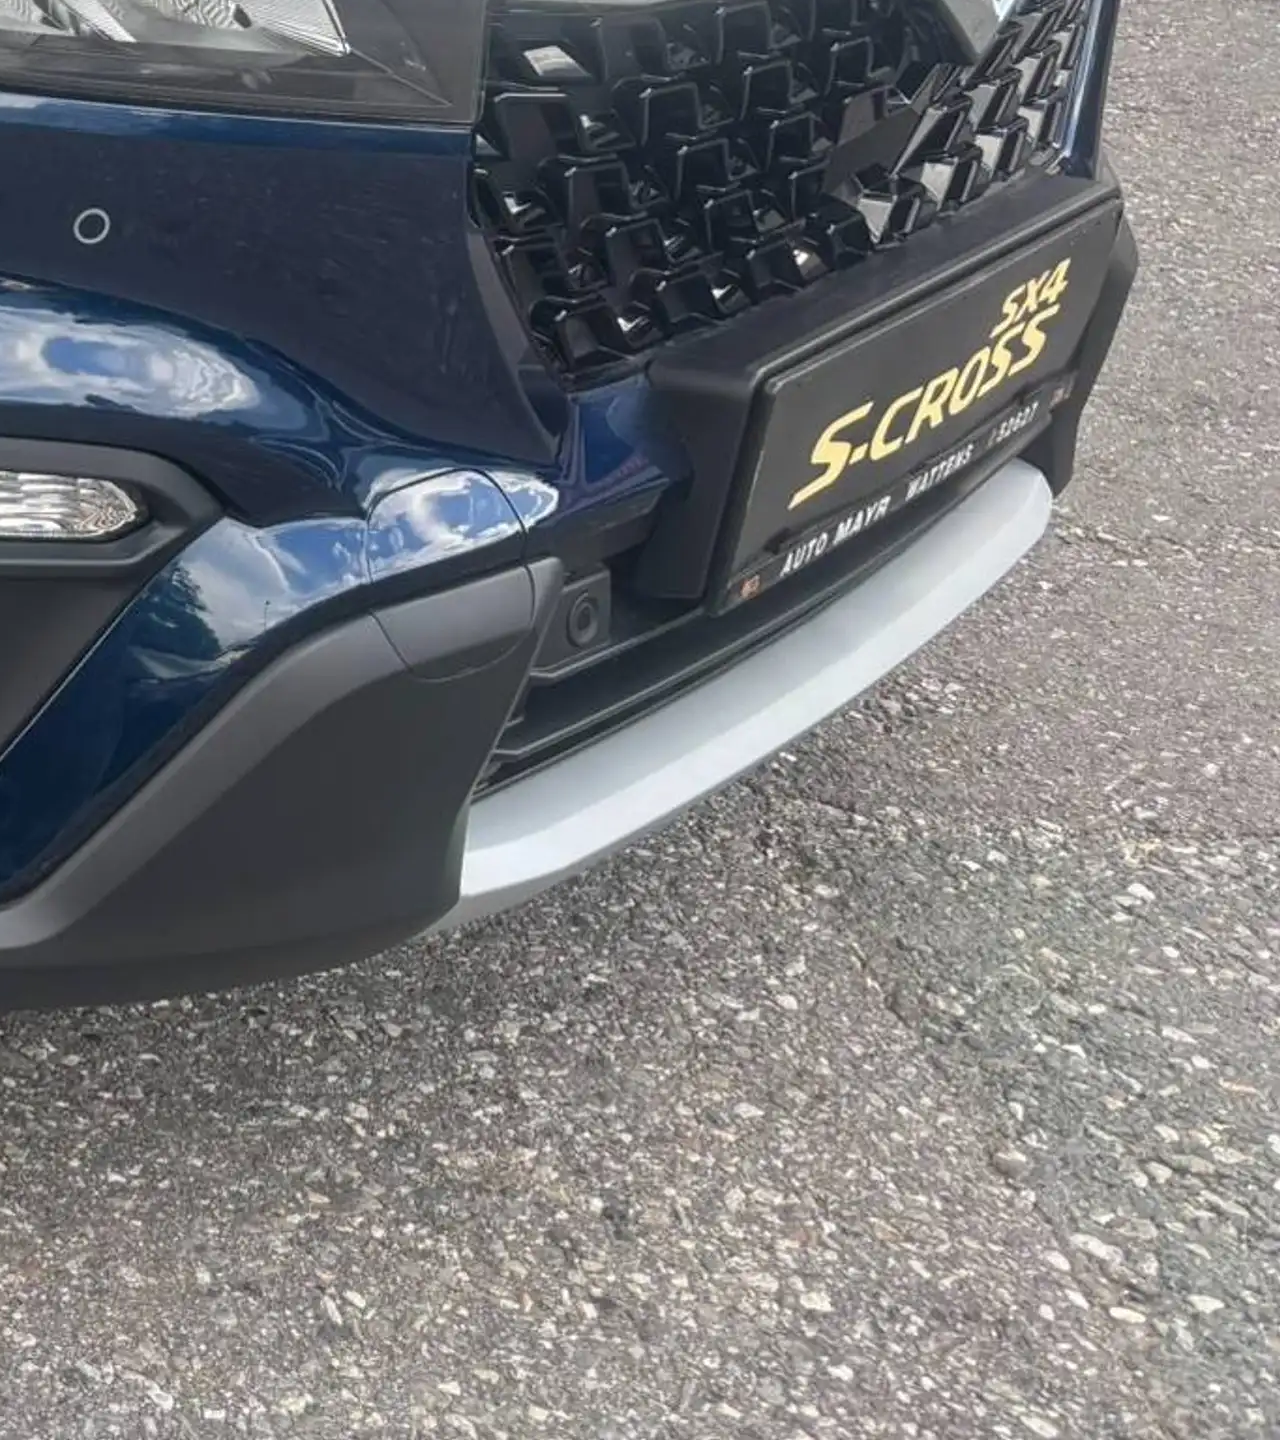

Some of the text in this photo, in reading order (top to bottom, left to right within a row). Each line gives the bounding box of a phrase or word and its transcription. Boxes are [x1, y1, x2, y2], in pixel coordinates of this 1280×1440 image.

[990, 257, 1072, 339] SX4
[788, 304, 1061, 511] S-CROSS
[779, 531, 829, 578] AUTO
[832, 494, 892, 546] MAYR
[905, 443, 975, 502] WATTENS
